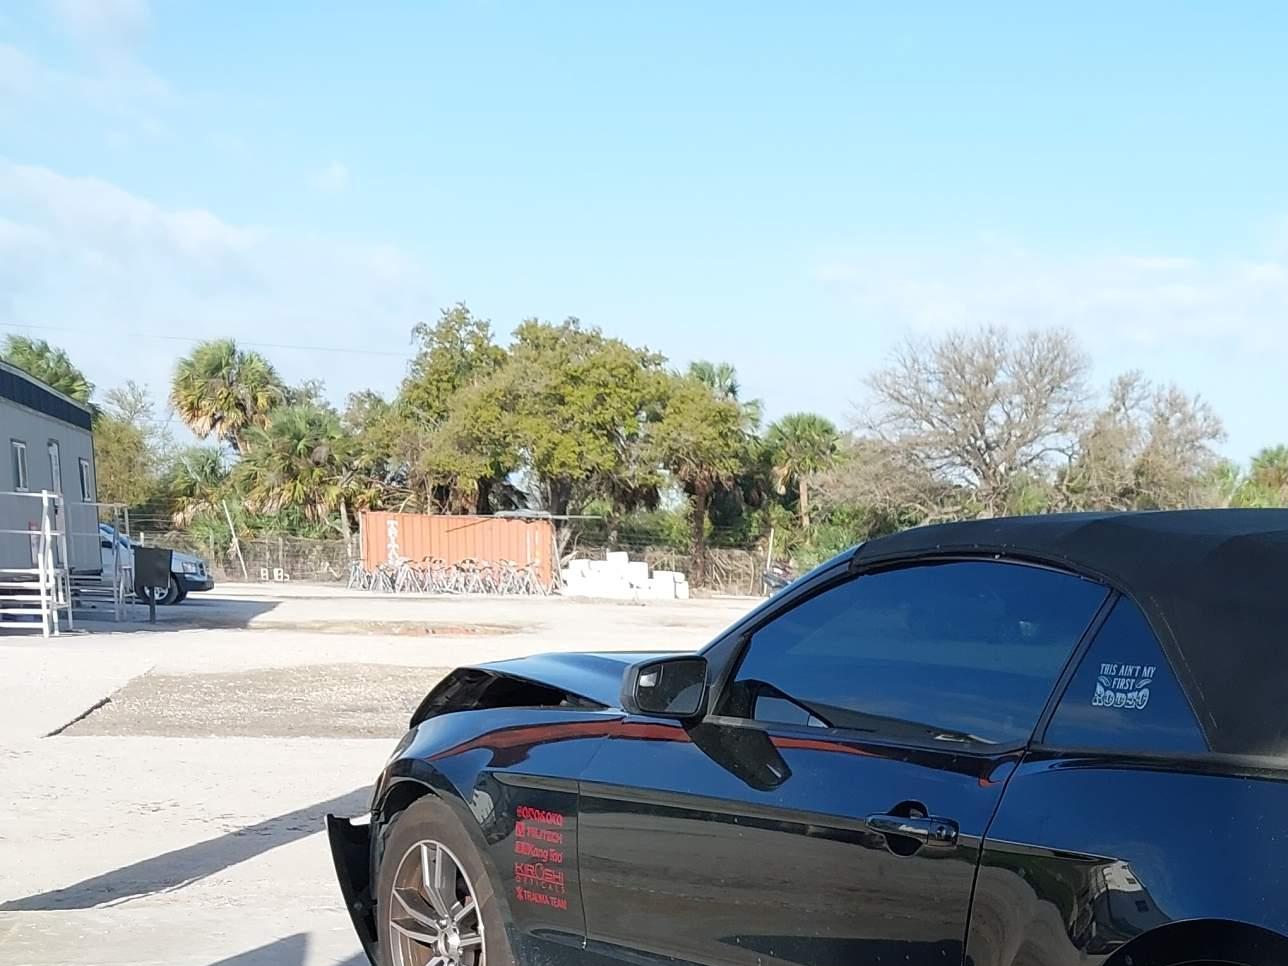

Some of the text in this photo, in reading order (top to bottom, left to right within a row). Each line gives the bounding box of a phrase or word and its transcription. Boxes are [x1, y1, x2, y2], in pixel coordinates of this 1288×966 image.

[1099, 663, 1156, 677] THIS AIN'T MY
[1111, 678, 1135, 690] FIRST
[1092, 682, 1149, 709] RODEO
